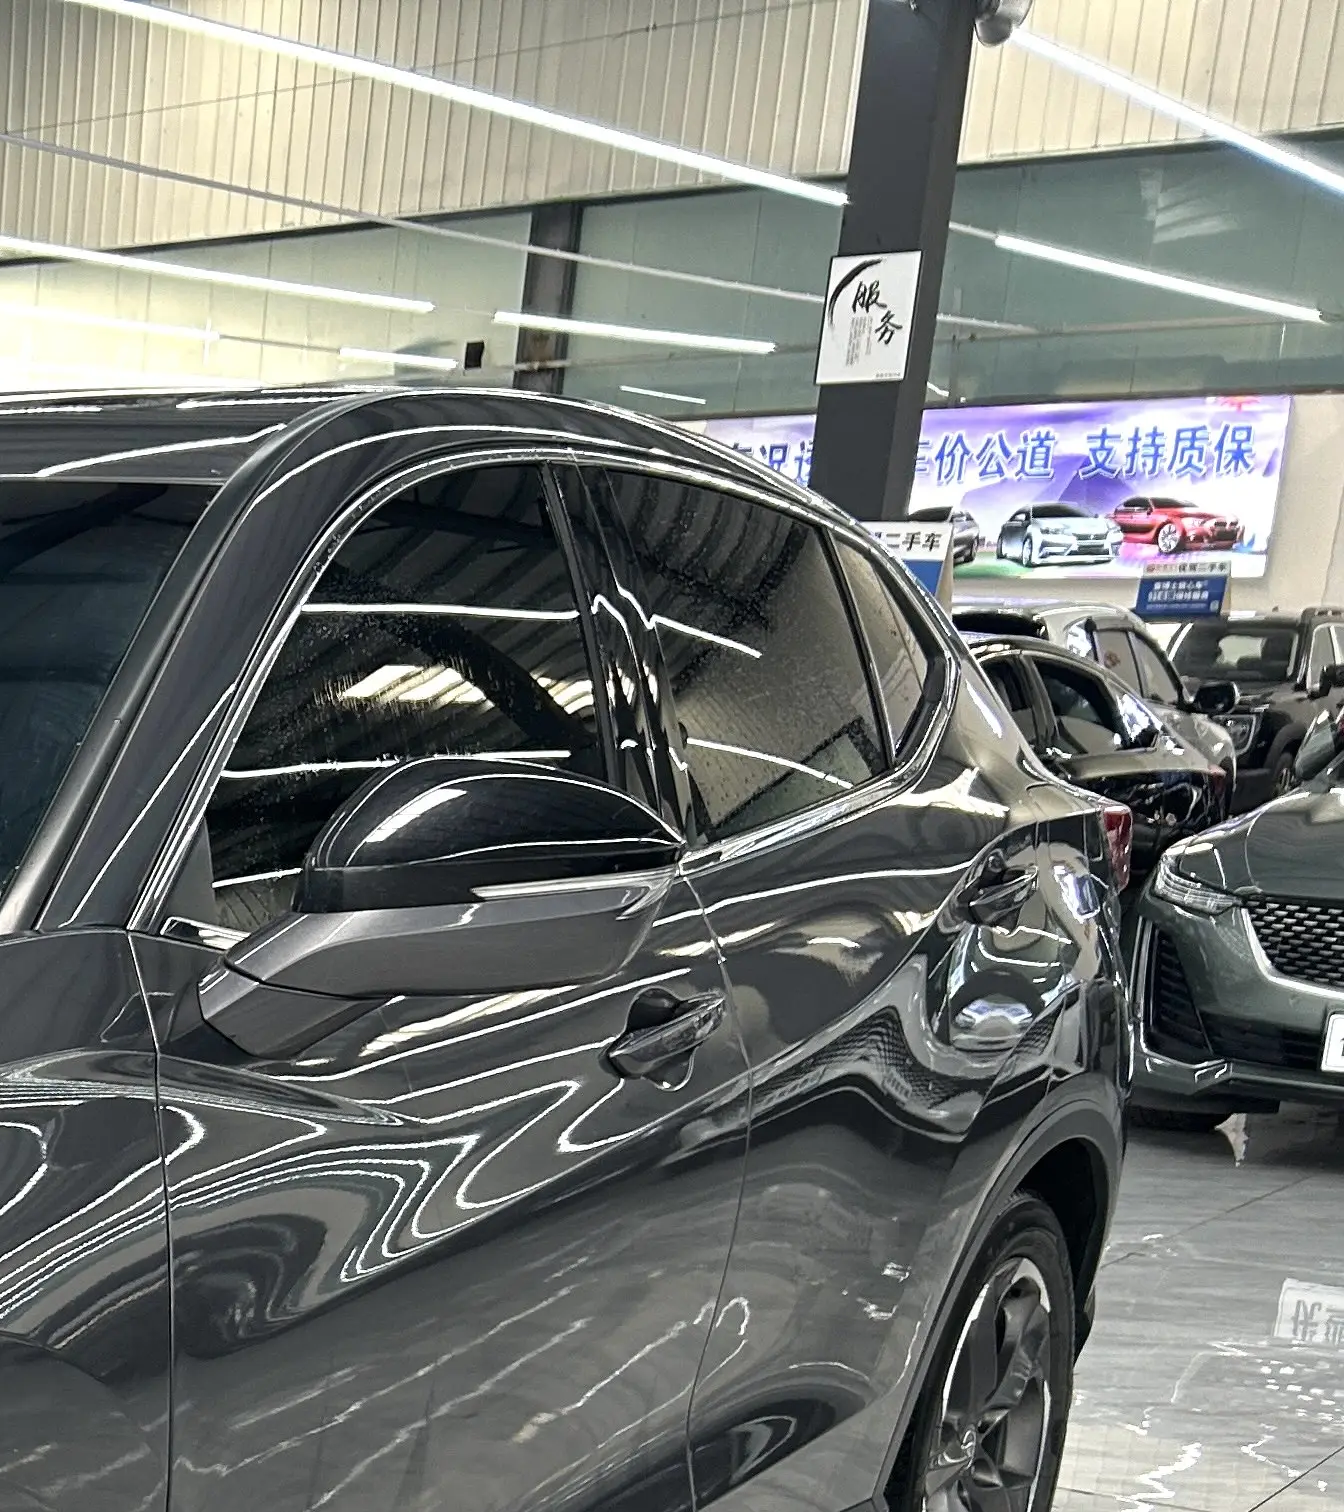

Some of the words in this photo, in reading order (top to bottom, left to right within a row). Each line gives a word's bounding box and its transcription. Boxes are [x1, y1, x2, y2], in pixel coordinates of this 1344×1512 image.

[851, 279, 903, 345] 服务
[1079, 423, 1256, 479] 支持质保
[874, 531, 942, 552] 二手车
